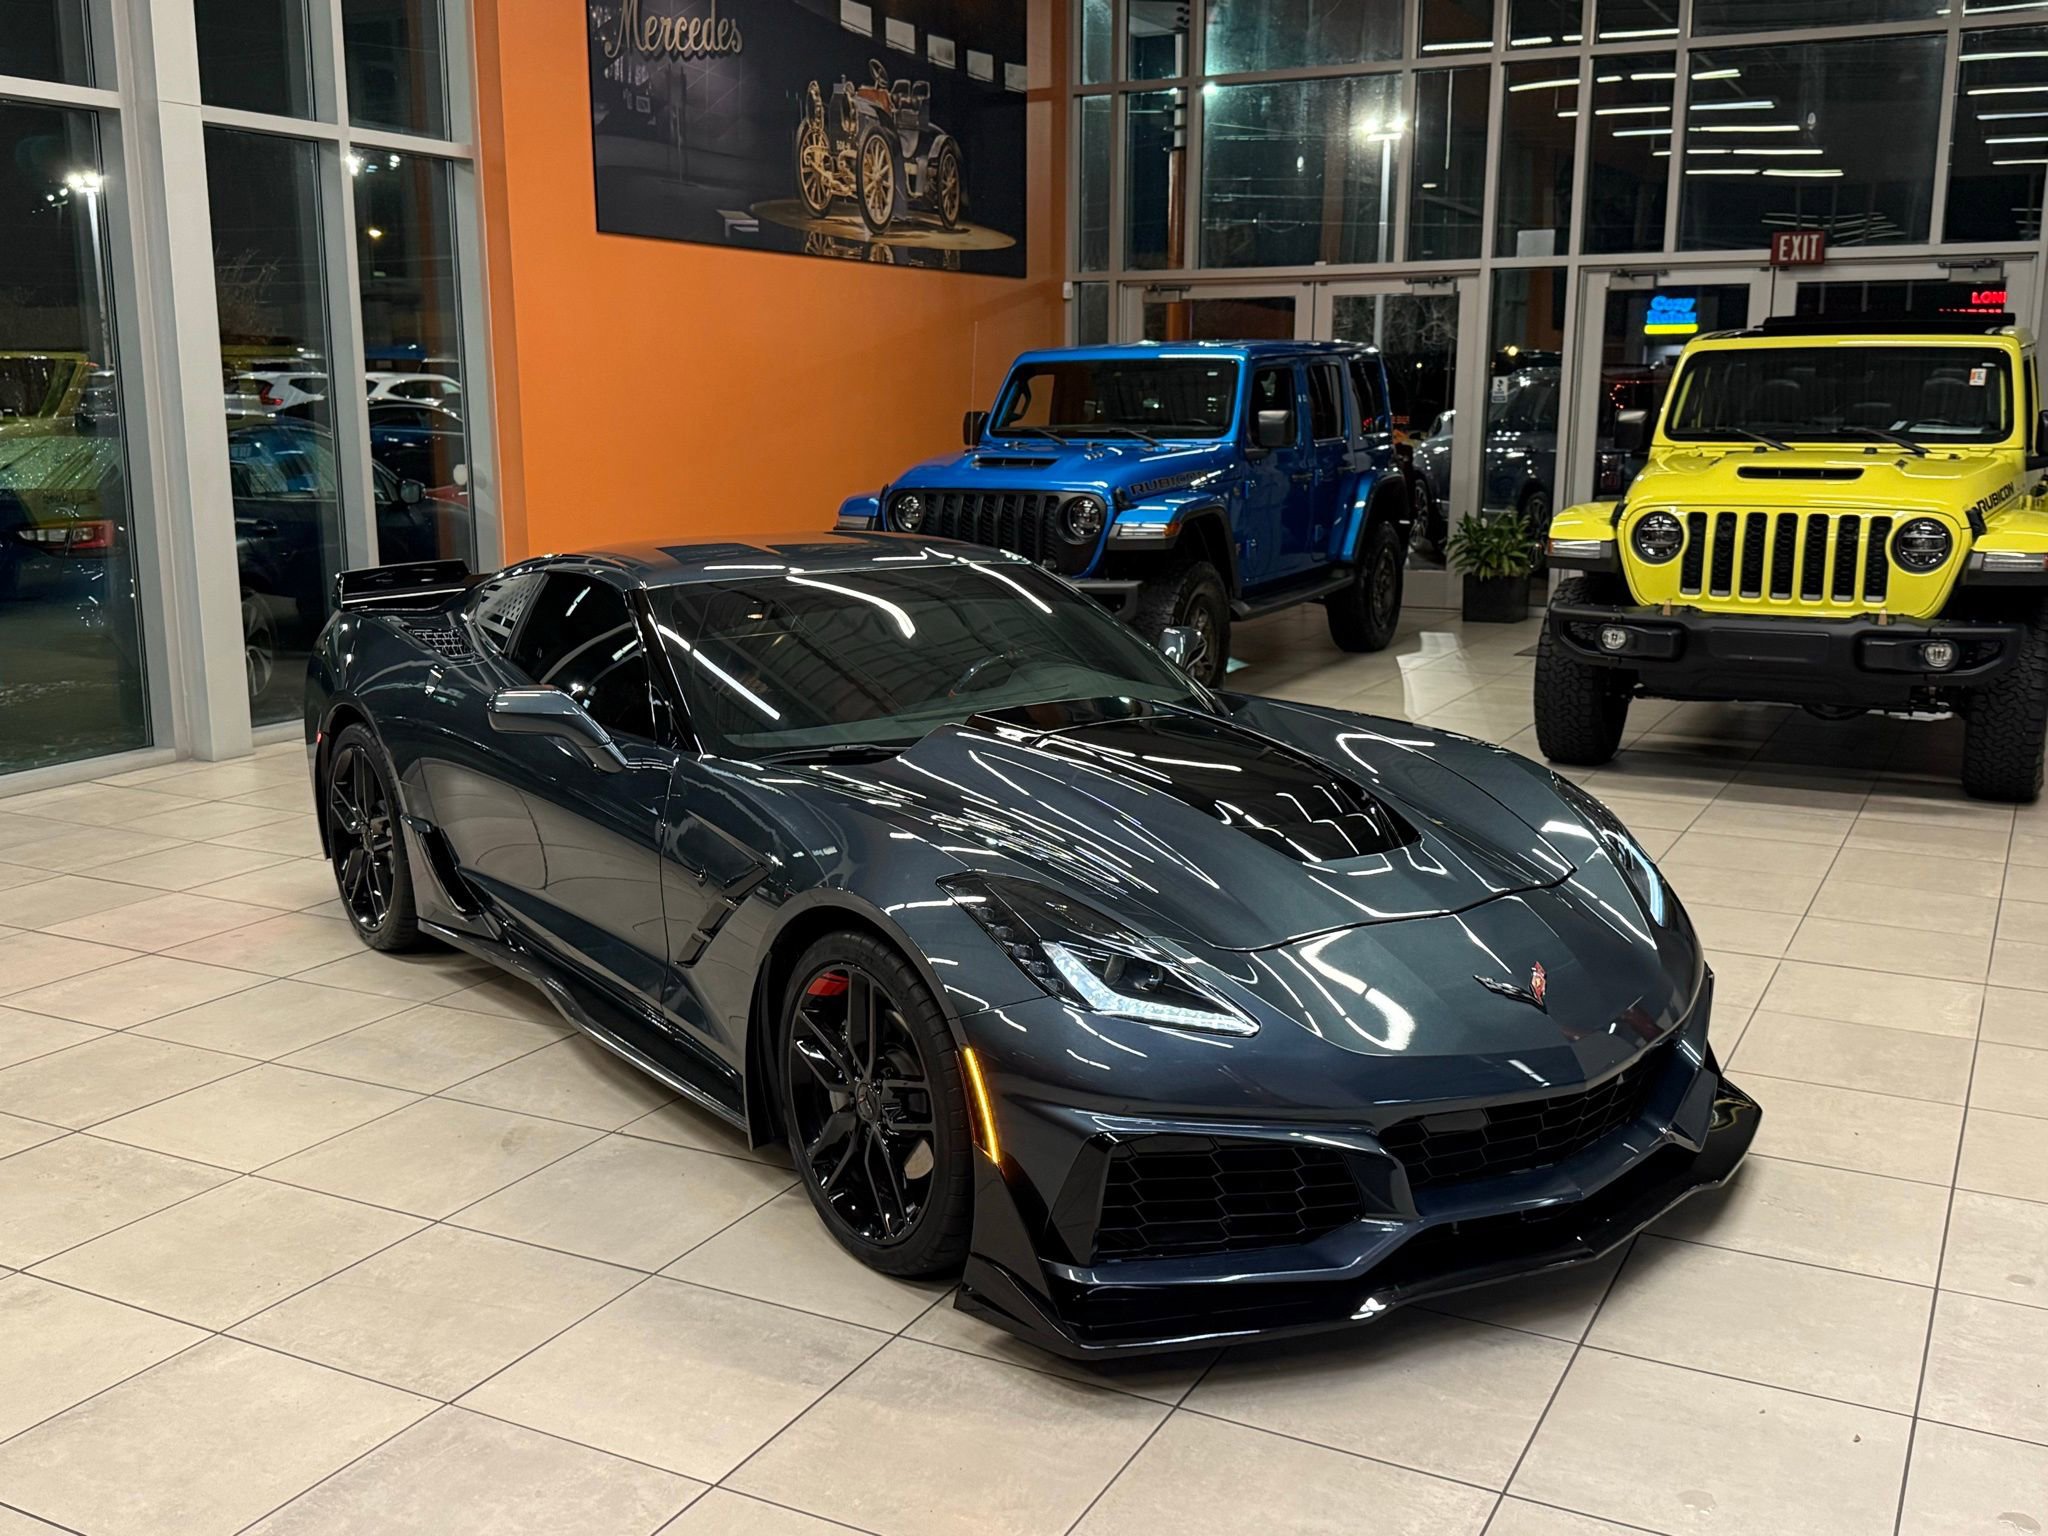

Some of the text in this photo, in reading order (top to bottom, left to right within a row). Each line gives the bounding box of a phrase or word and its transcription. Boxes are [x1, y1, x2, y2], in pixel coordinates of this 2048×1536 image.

[604, 0, 743, 58] Mercedes
[1778, 234, 1821, 261] EXIT
[1976, 481, 2015, 512] RUBICON
